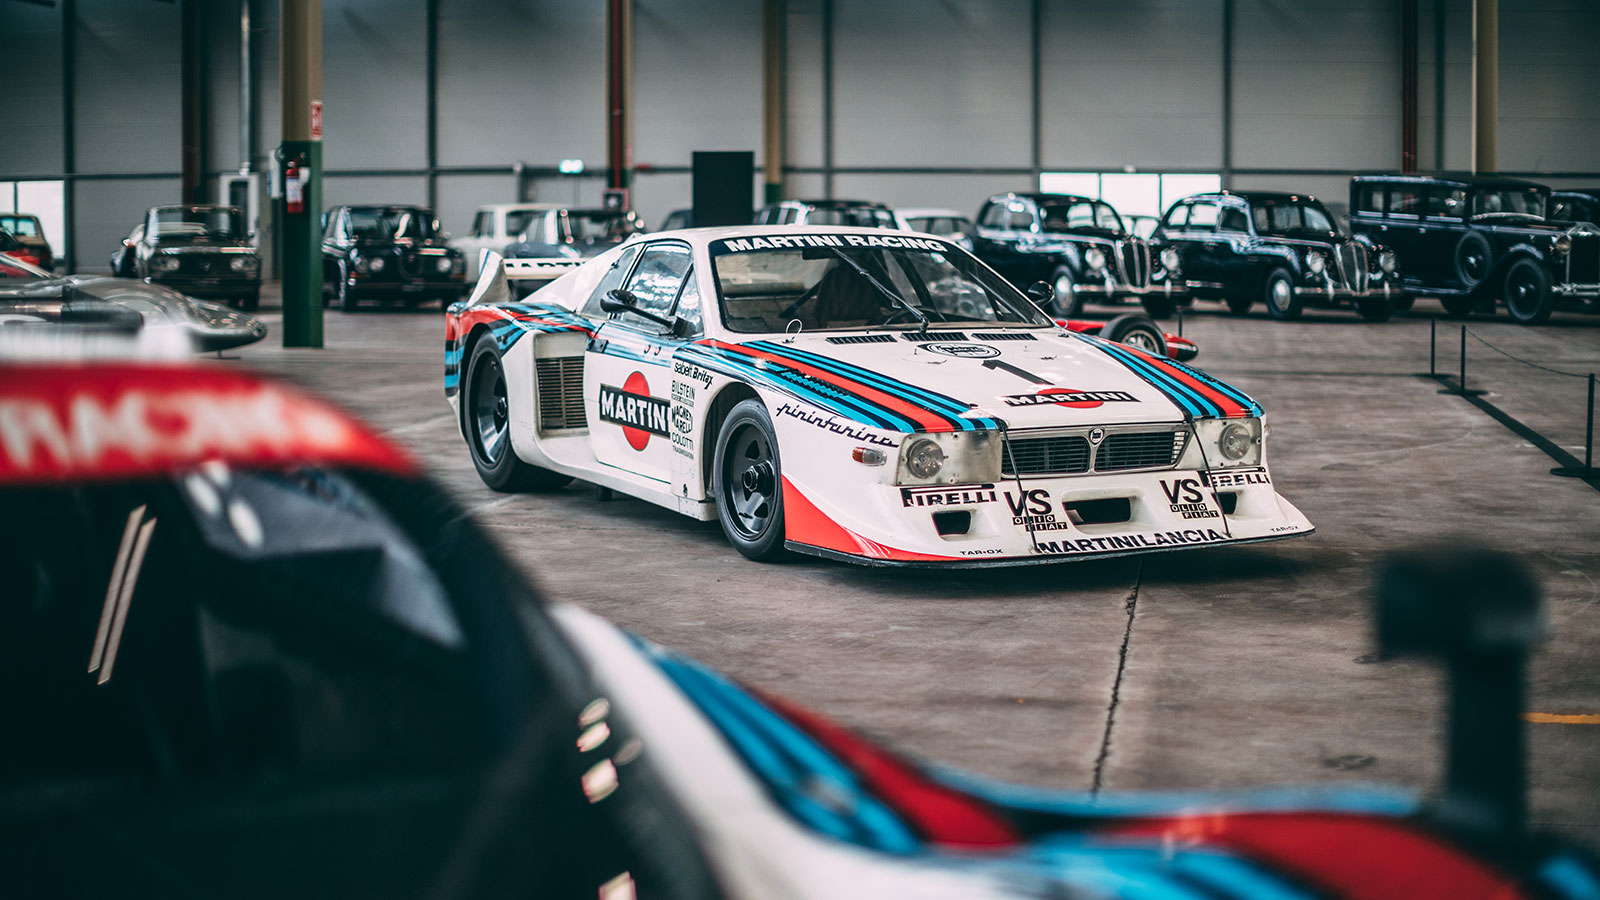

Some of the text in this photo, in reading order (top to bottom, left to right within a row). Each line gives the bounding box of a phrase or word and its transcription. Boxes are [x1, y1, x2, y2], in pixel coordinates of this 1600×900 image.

[724, 235, 948, 252] MARTINI RACING
[692, 367, 714, 390] Britax
[982, 359, 1055, 385] 1
[672, 380, 695, 400] BILSTEIN
[1011, 392, 1129, 406] MARTINI
[776, 403, 899, 448] pininfarina
[900, 484, 998, 507] PIRELLI
[1003, 489, 1052, 517] VS
[1159, 479, 1203, 504] VS
[1171, 504, 1207, 512] OLIO
[1183, 511, 1218, 519] FIAT
